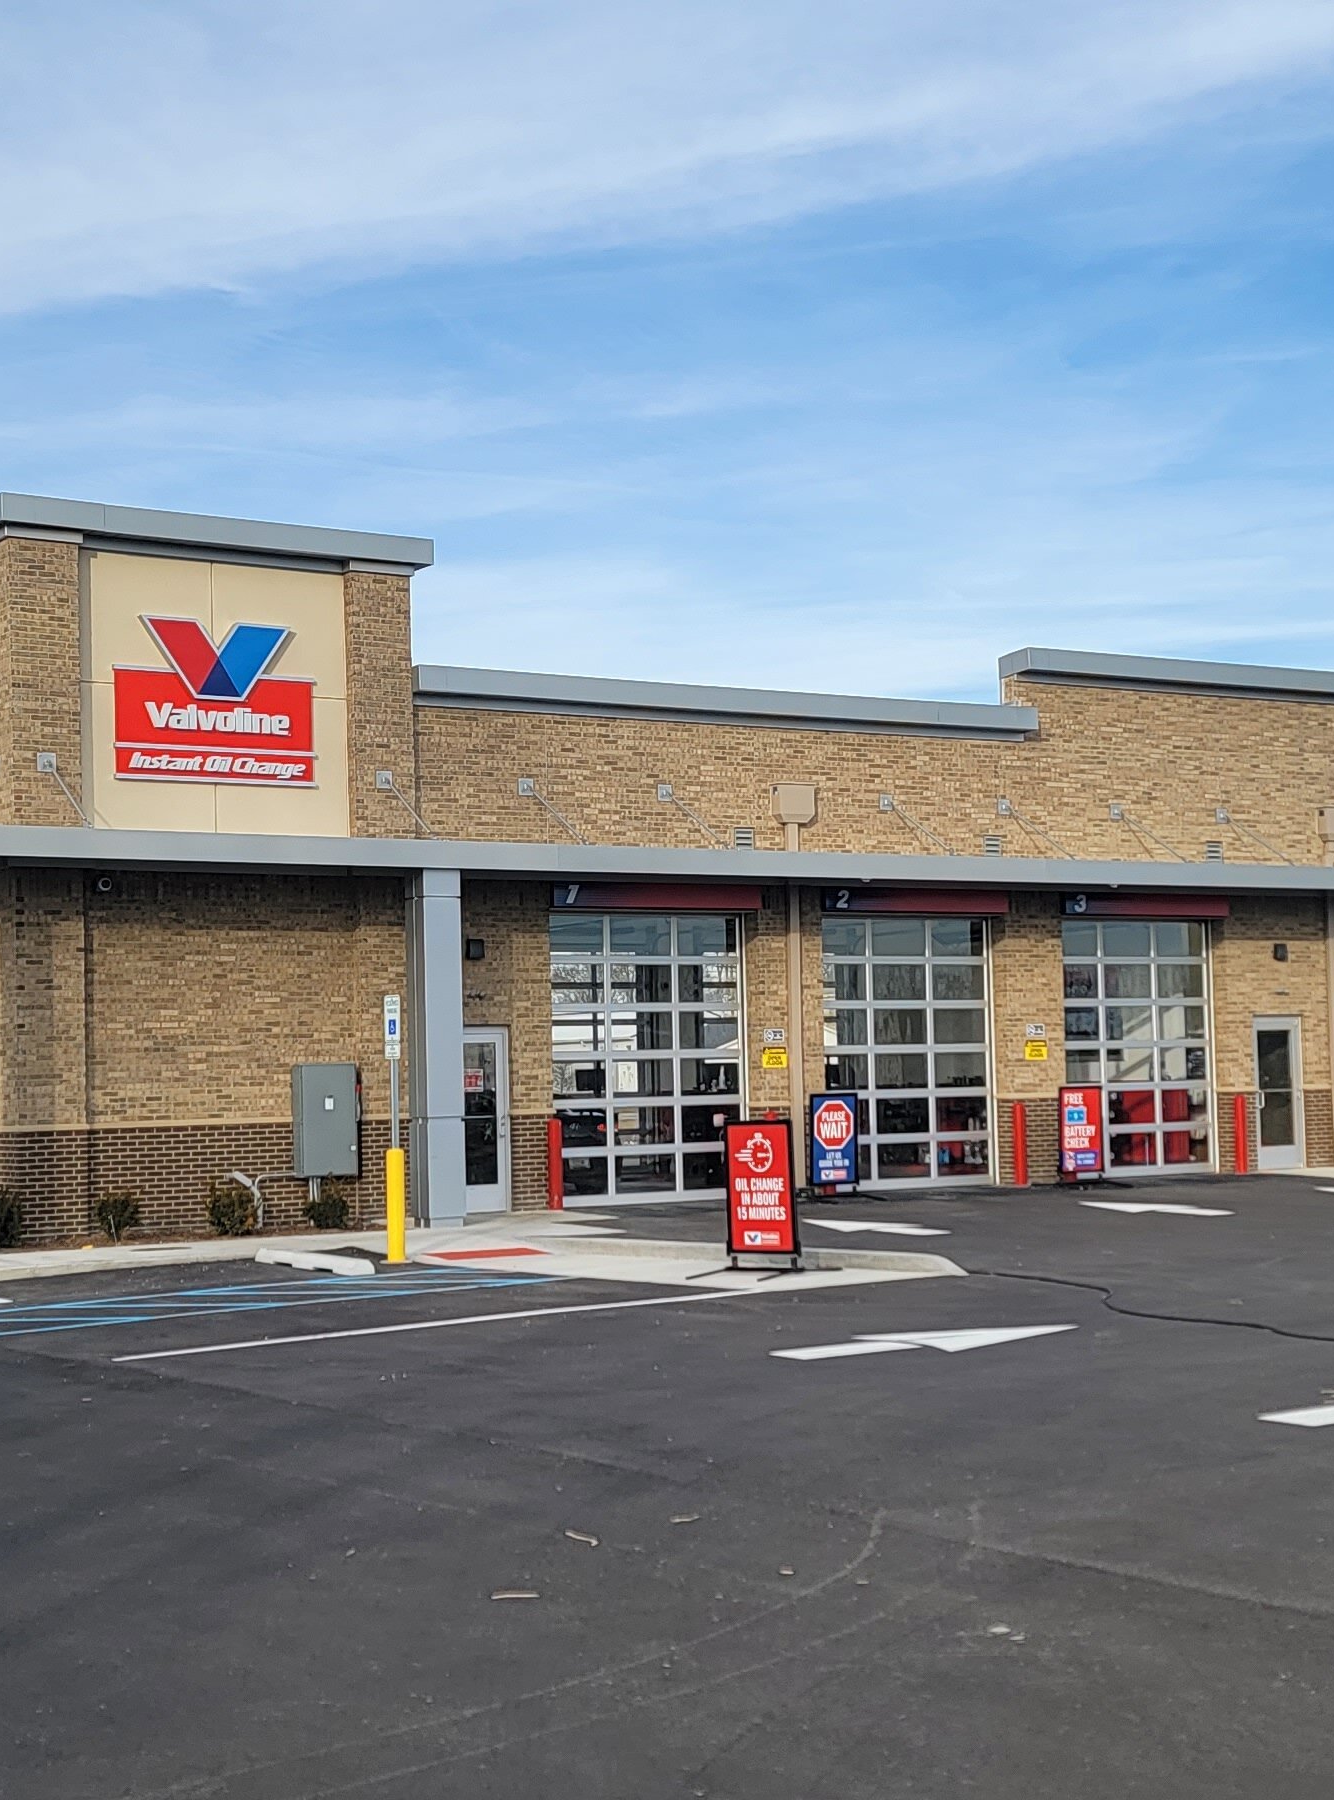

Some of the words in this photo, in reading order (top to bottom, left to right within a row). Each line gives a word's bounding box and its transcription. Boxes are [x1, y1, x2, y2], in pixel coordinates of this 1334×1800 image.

[144, 701, 291, 736] Valvoline
[128, 752, 203, 771] Instant
[203, 755, 232, 773] Oil
[230, 757, 306, 779] Change
[566, 885, 579, 903] 1
[836, 890, 849, 908] 2
[1075, 895, 1086, 912] 3
[1064, 1093, 1084, 1105] FREE
[821, 1110, 846, 1122] PLEASE
[819, 1121, 848, 1139] WAIT
[1064, 1125, 1096, 1137] BATTERY
[1064, 1137, 1090, 1149] CHECK
[734, 1177, 750, 1192] OIL
[750, 1177, 785, 1192] CHANGE
[740, 1192, 751, 1206] IN
[752, 1192, 780, 1206] ABOUT
[736, 1206, 747, 1221] 15
[748, 1206, 787, 1221] MINUTES
